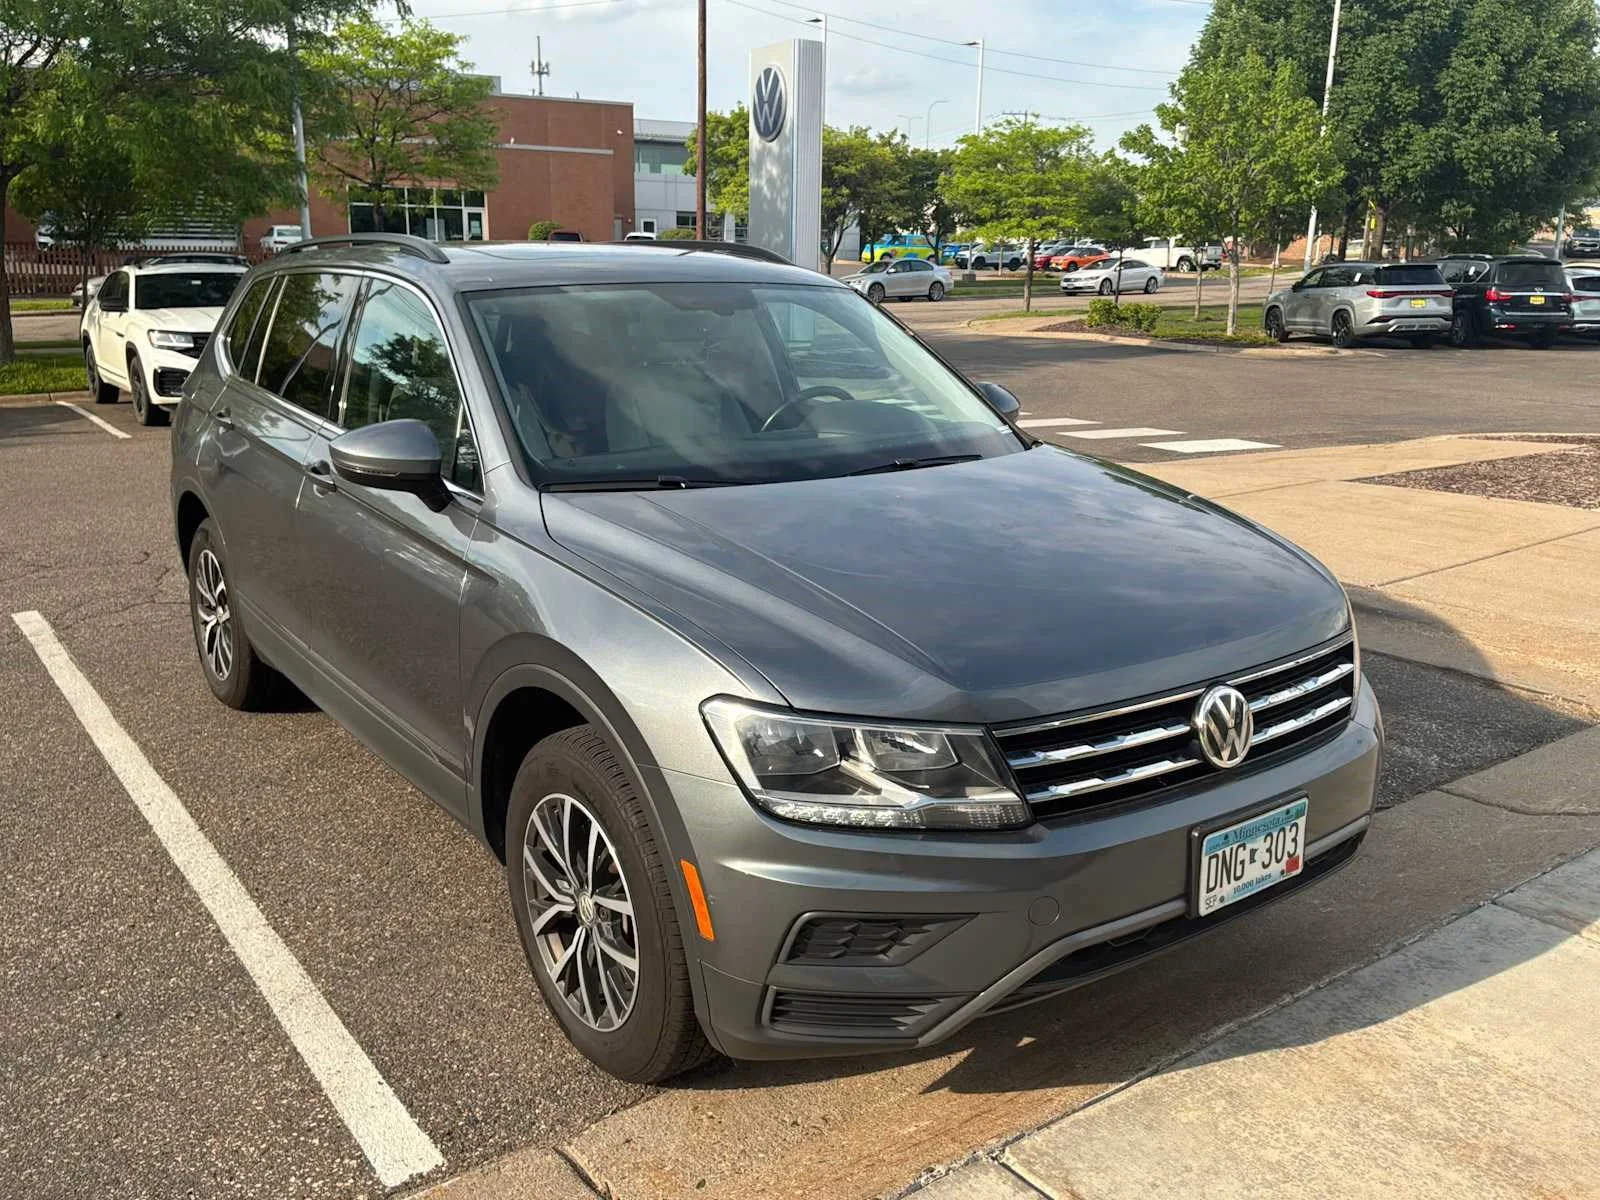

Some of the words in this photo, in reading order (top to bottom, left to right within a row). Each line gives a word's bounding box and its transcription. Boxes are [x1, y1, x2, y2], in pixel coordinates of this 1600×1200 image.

[753, 66, 785, 137] VW
[1200, 689, 1250, 764] VW
[1232, 816, 1281, 842] Minnesota
[1206, 843, 1247, 894] DNG
[1262, 822, 1299, 869] 303
[1255, 873, 1272, 885] lakes
[1205, 894, 1218, 910] SEP
